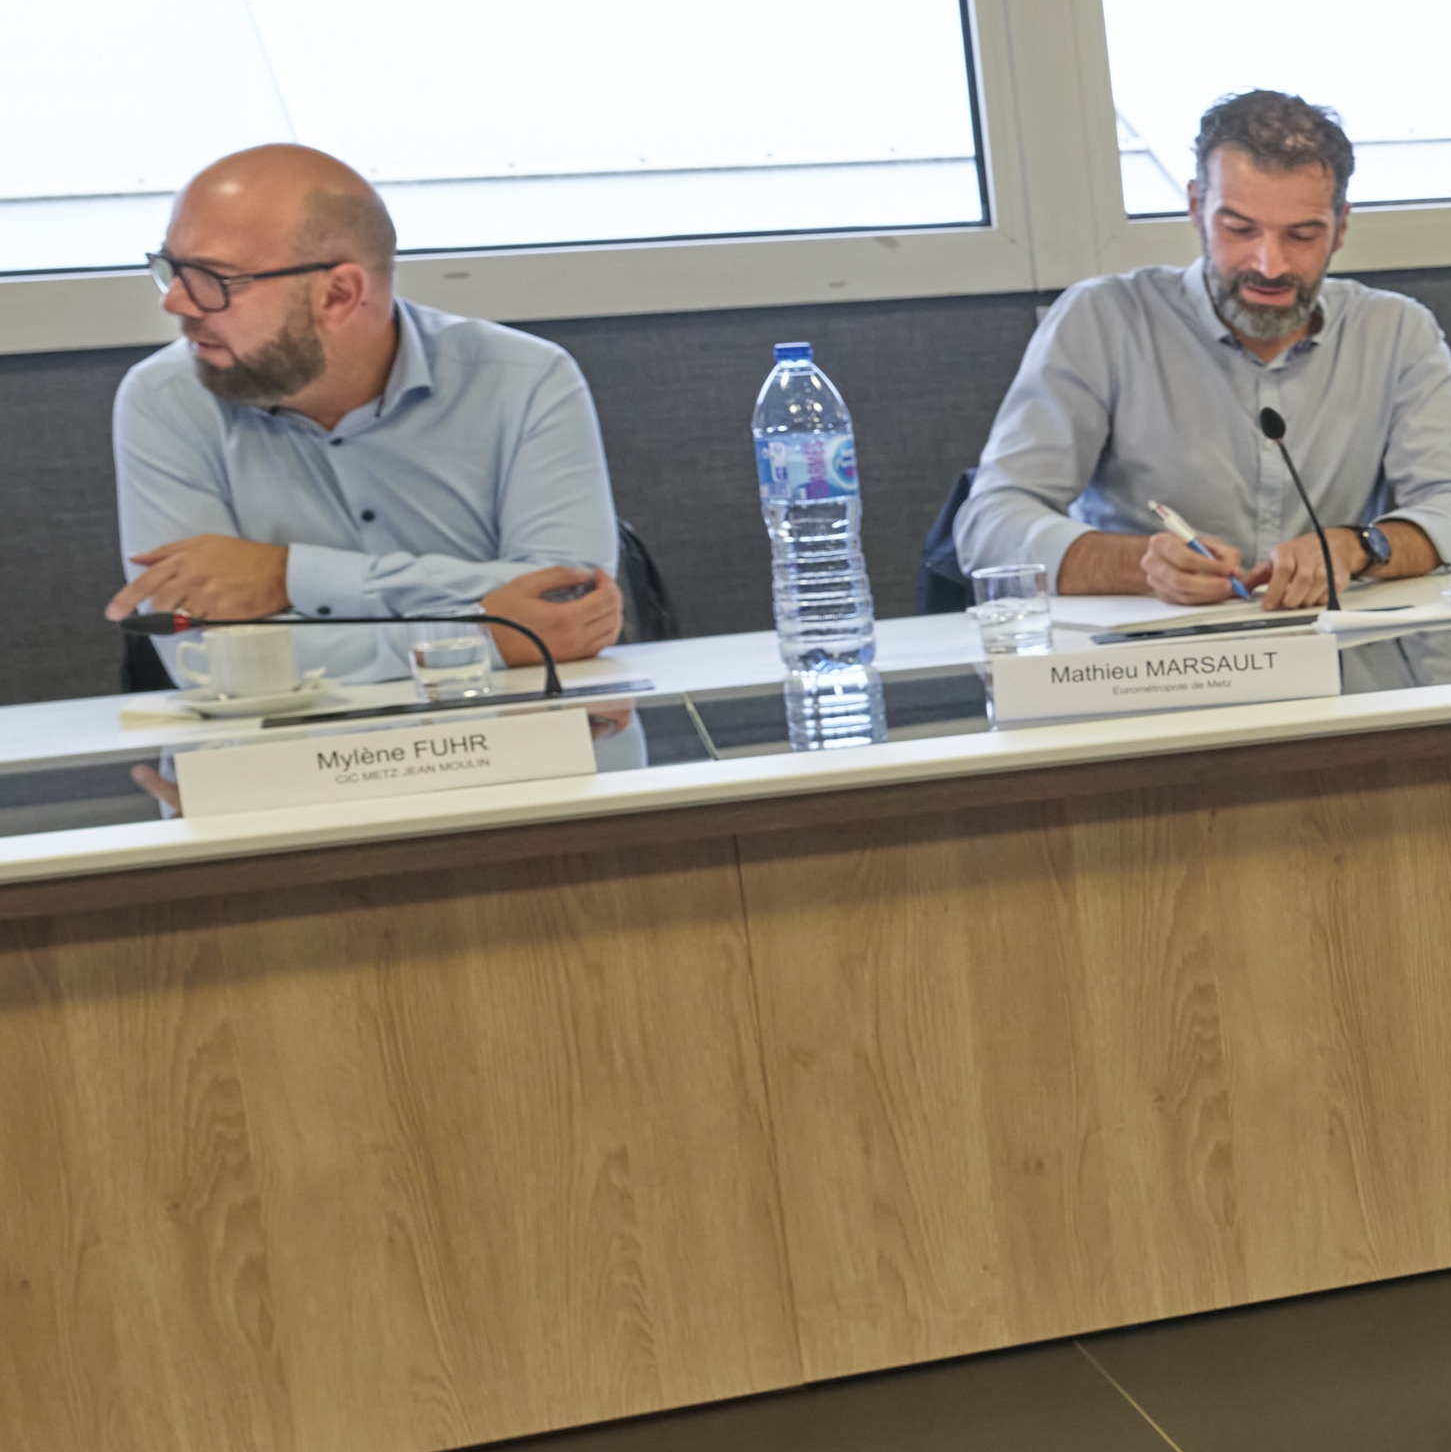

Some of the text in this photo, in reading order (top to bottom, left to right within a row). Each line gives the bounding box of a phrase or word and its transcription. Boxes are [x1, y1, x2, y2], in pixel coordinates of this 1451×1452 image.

[1050, 651, 1277, 684] Mathieu MARSAULT
[1112, 679, 1232, 696] Eurométropole de Metz
[316, 733, 488, 772] Mylène FUHR
[335, 758, 490, 784] CIC METZ JEAN MOULIN
